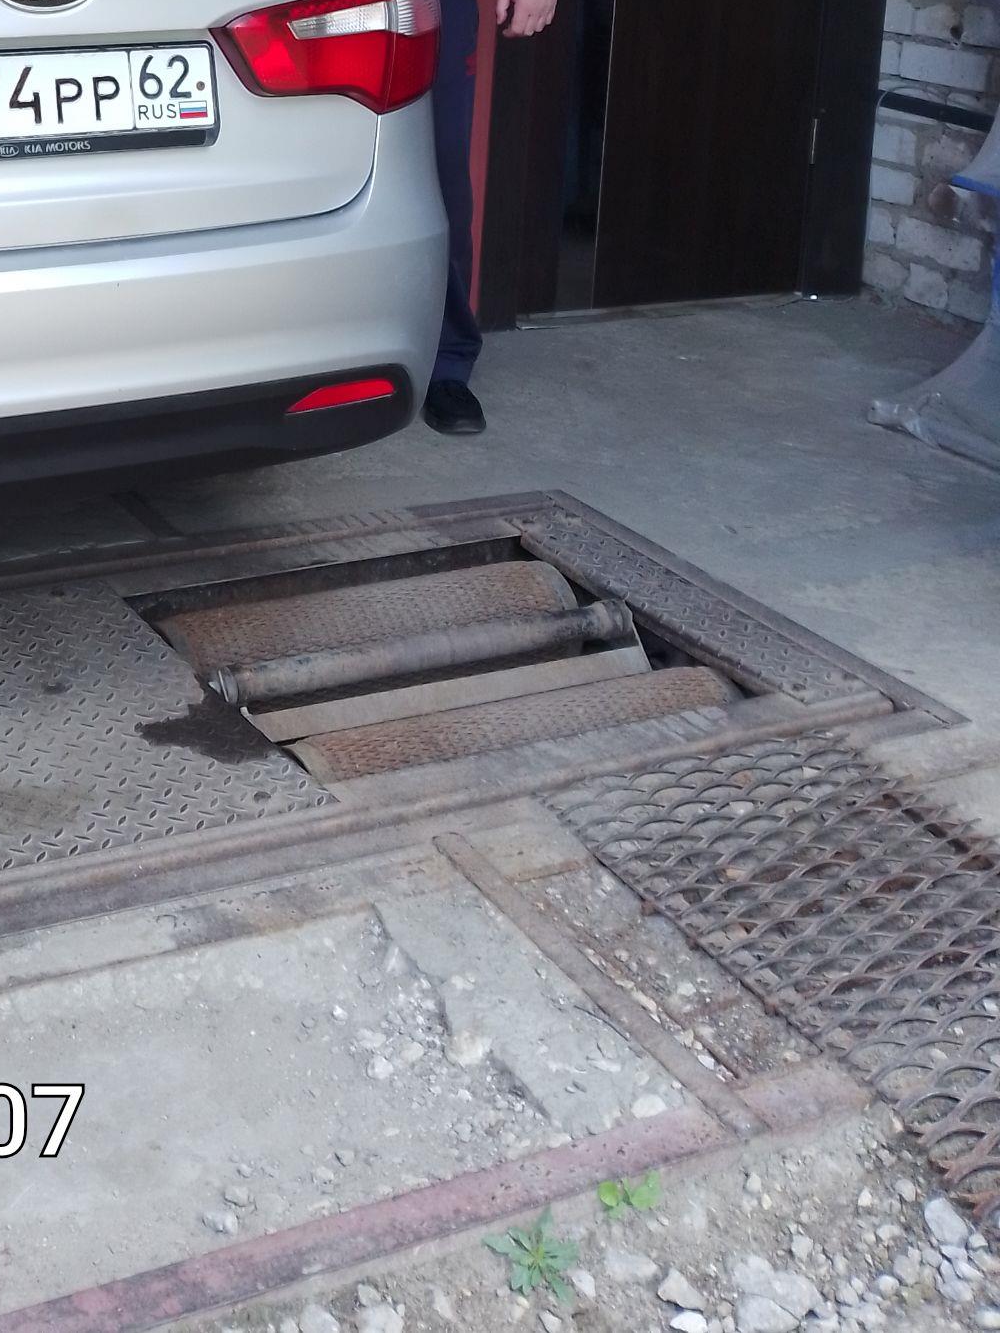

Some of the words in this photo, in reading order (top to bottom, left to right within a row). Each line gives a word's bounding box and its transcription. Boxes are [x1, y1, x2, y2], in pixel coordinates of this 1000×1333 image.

[139, 53, 192, 100] 62
[138, 103, 177, 121] RUS
[24, 144, 43, 154] KIA
[46, 140, 91, 153] MOTORS
